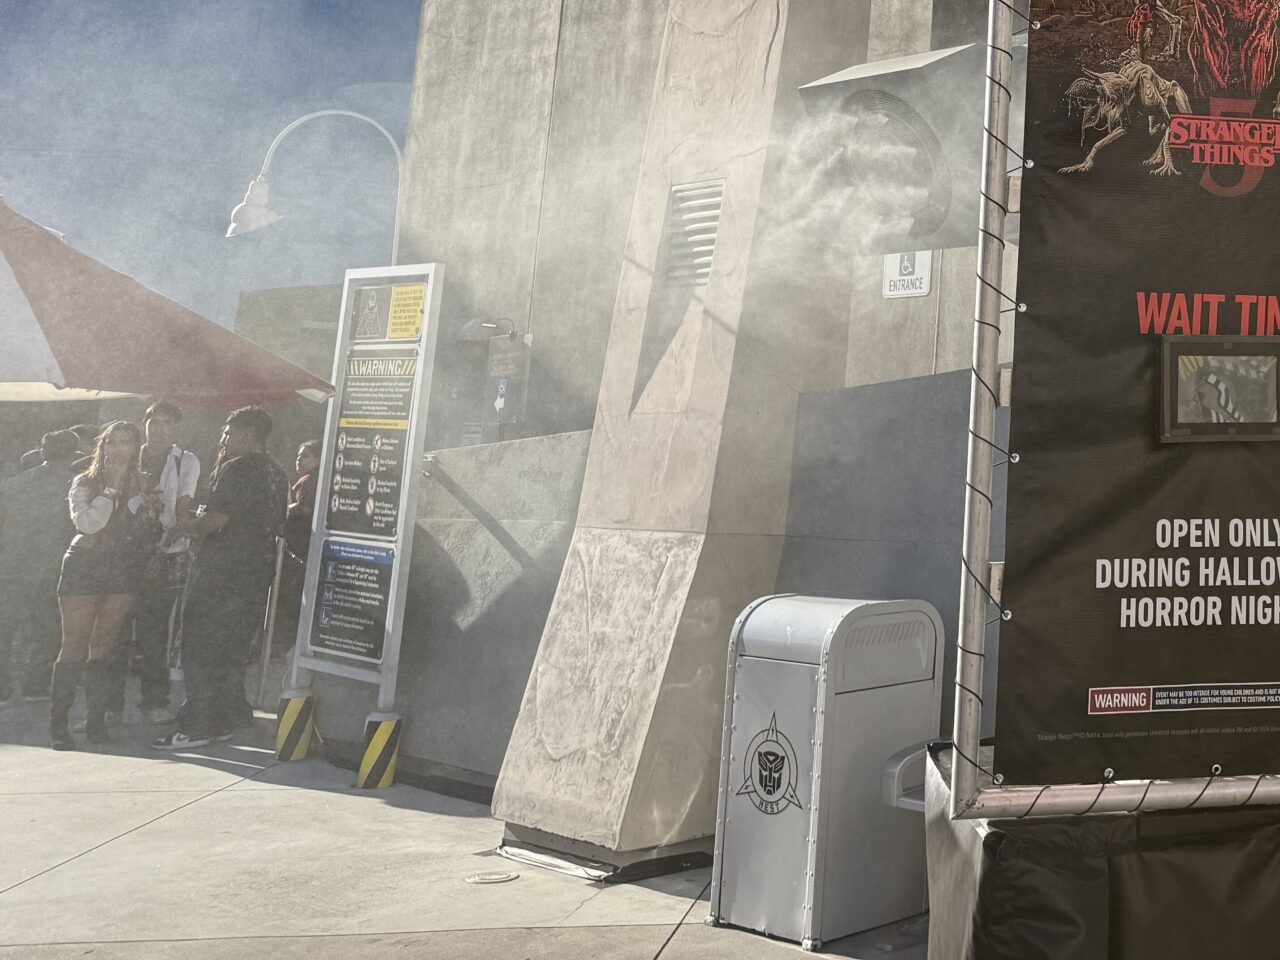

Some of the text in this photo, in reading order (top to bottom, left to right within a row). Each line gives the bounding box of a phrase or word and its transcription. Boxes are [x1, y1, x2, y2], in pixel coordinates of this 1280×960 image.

[1189, 143, 1275, 167] THINGS
[889, 277, 924, 292] ENTRANCE
[1136, 292, 1225, 336] WAIT
[360, 360, 402, 375] WARNING
[1156, 518, 1220, 548] OPEN
[1095, 557, 1191, 588] DURING
[1120, 595, 1222, 628] HORROR
[1094, 691, 1147, 708] WARNING
[1155, 691, 1169, 699] EVENT
[1155, 698, 1169, 706] UNDER
[758, 801, 780, 813] NEST
